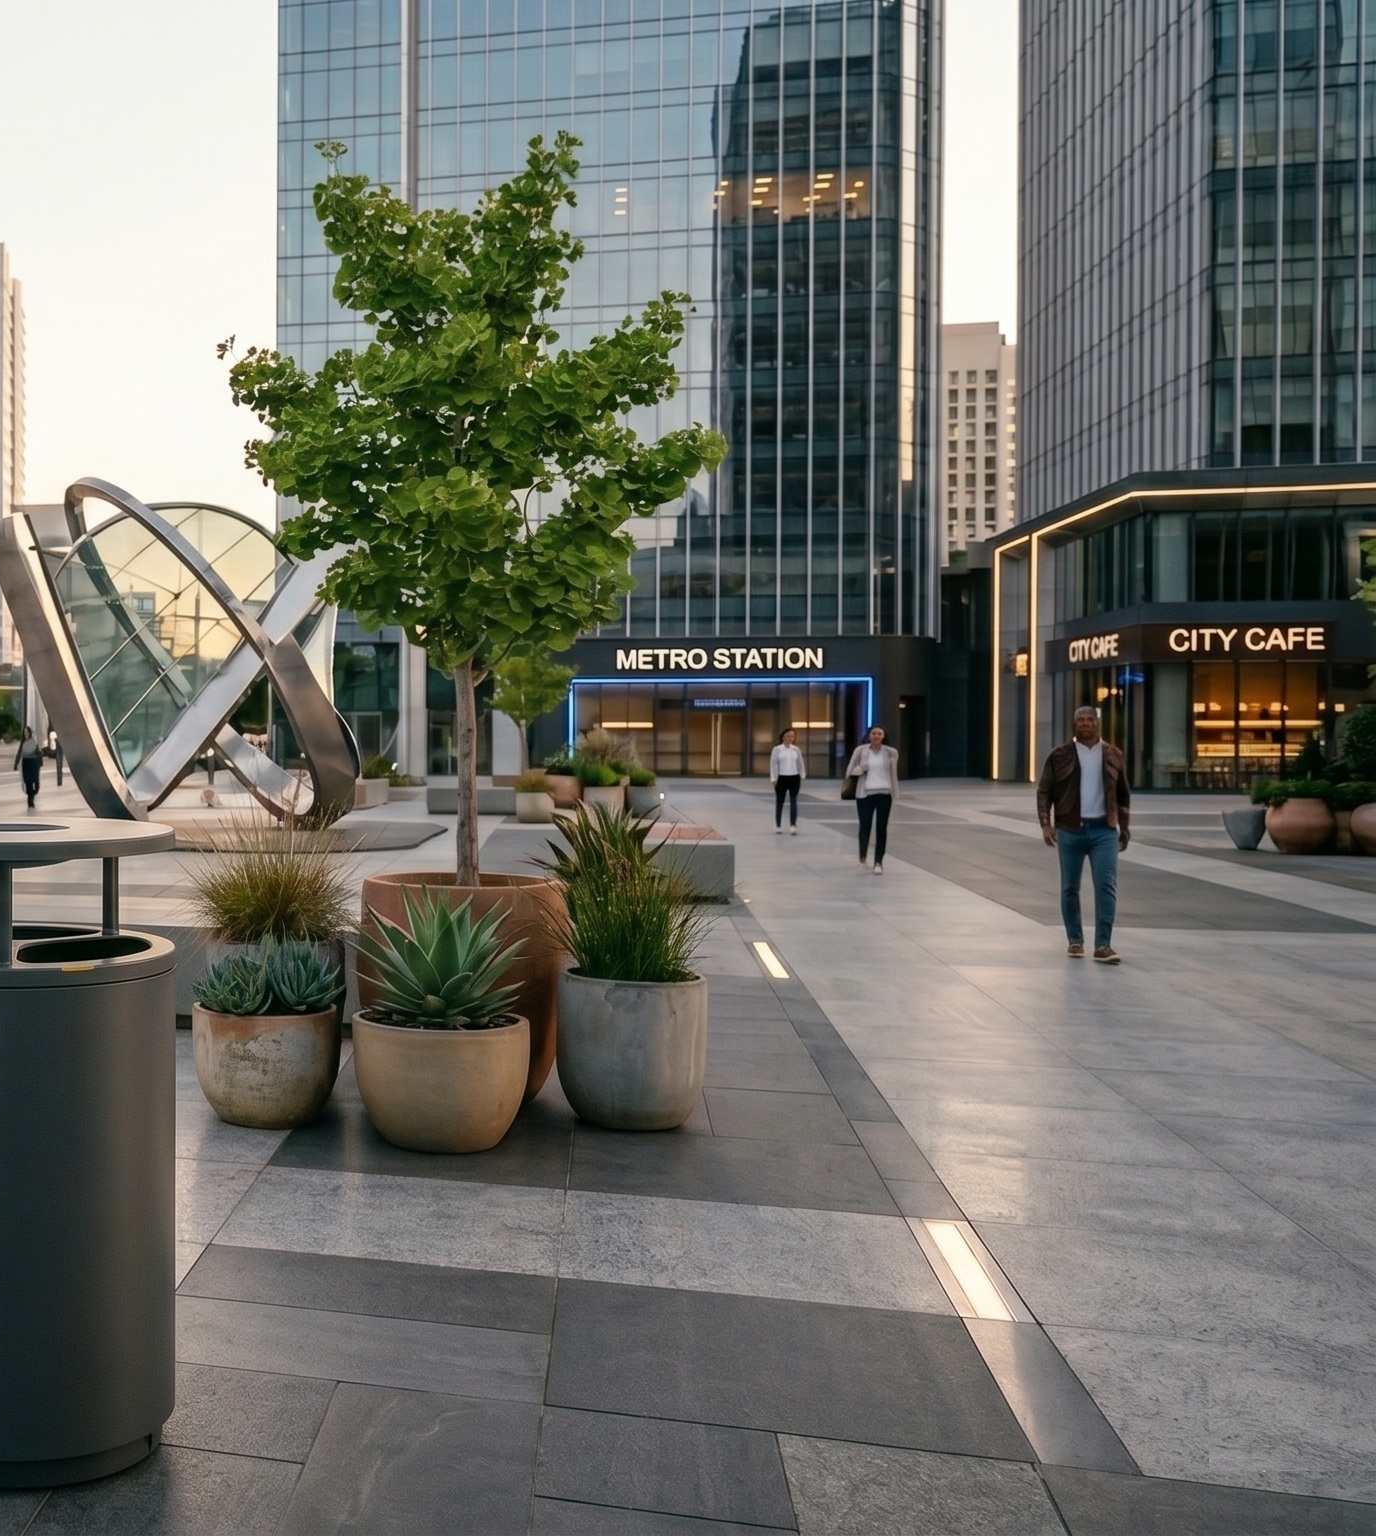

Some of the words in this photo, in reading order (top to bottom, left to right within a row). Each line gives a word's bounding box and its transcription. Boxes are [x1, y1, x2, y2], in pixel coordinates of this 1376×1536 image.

[1091, 633, 1119, 660] CAFE
[1169, 628, 1238, 652] CITY
[1244, 627, 1325, 651] CAFE
[616, 648, 708, 670] METRO
[713, 648, 823, 669] STATION
